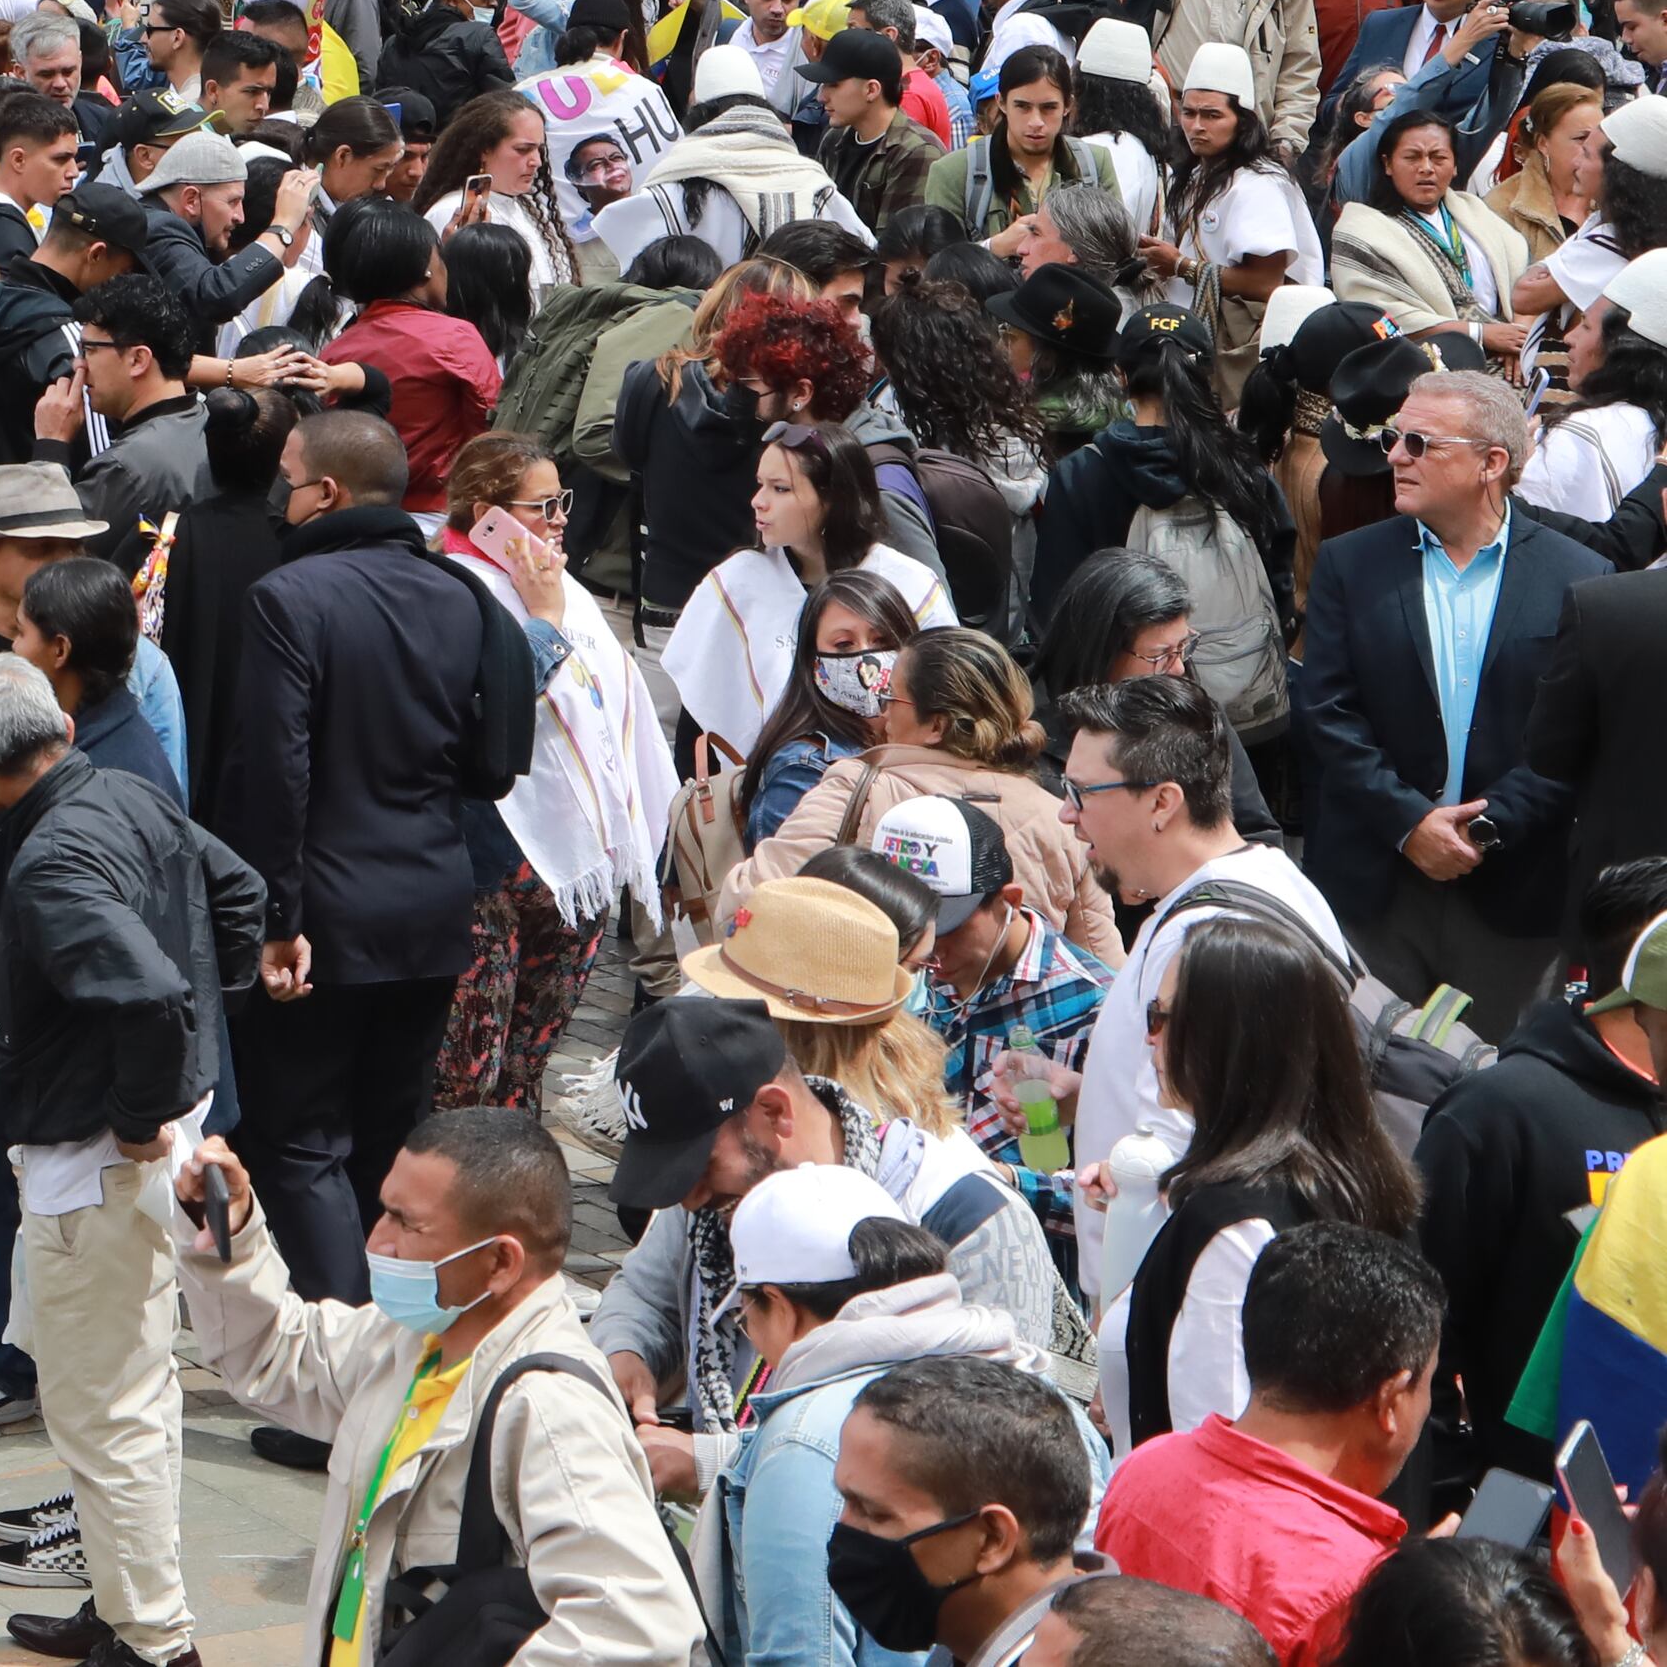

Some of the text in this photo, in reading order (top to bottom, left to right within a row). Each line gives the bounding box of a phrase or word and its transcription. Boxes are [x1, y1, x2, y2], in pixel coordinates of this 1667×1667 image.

[1150, 318, 1180, 332] FCF
[882, 836, 939, 859] PETRO Y
